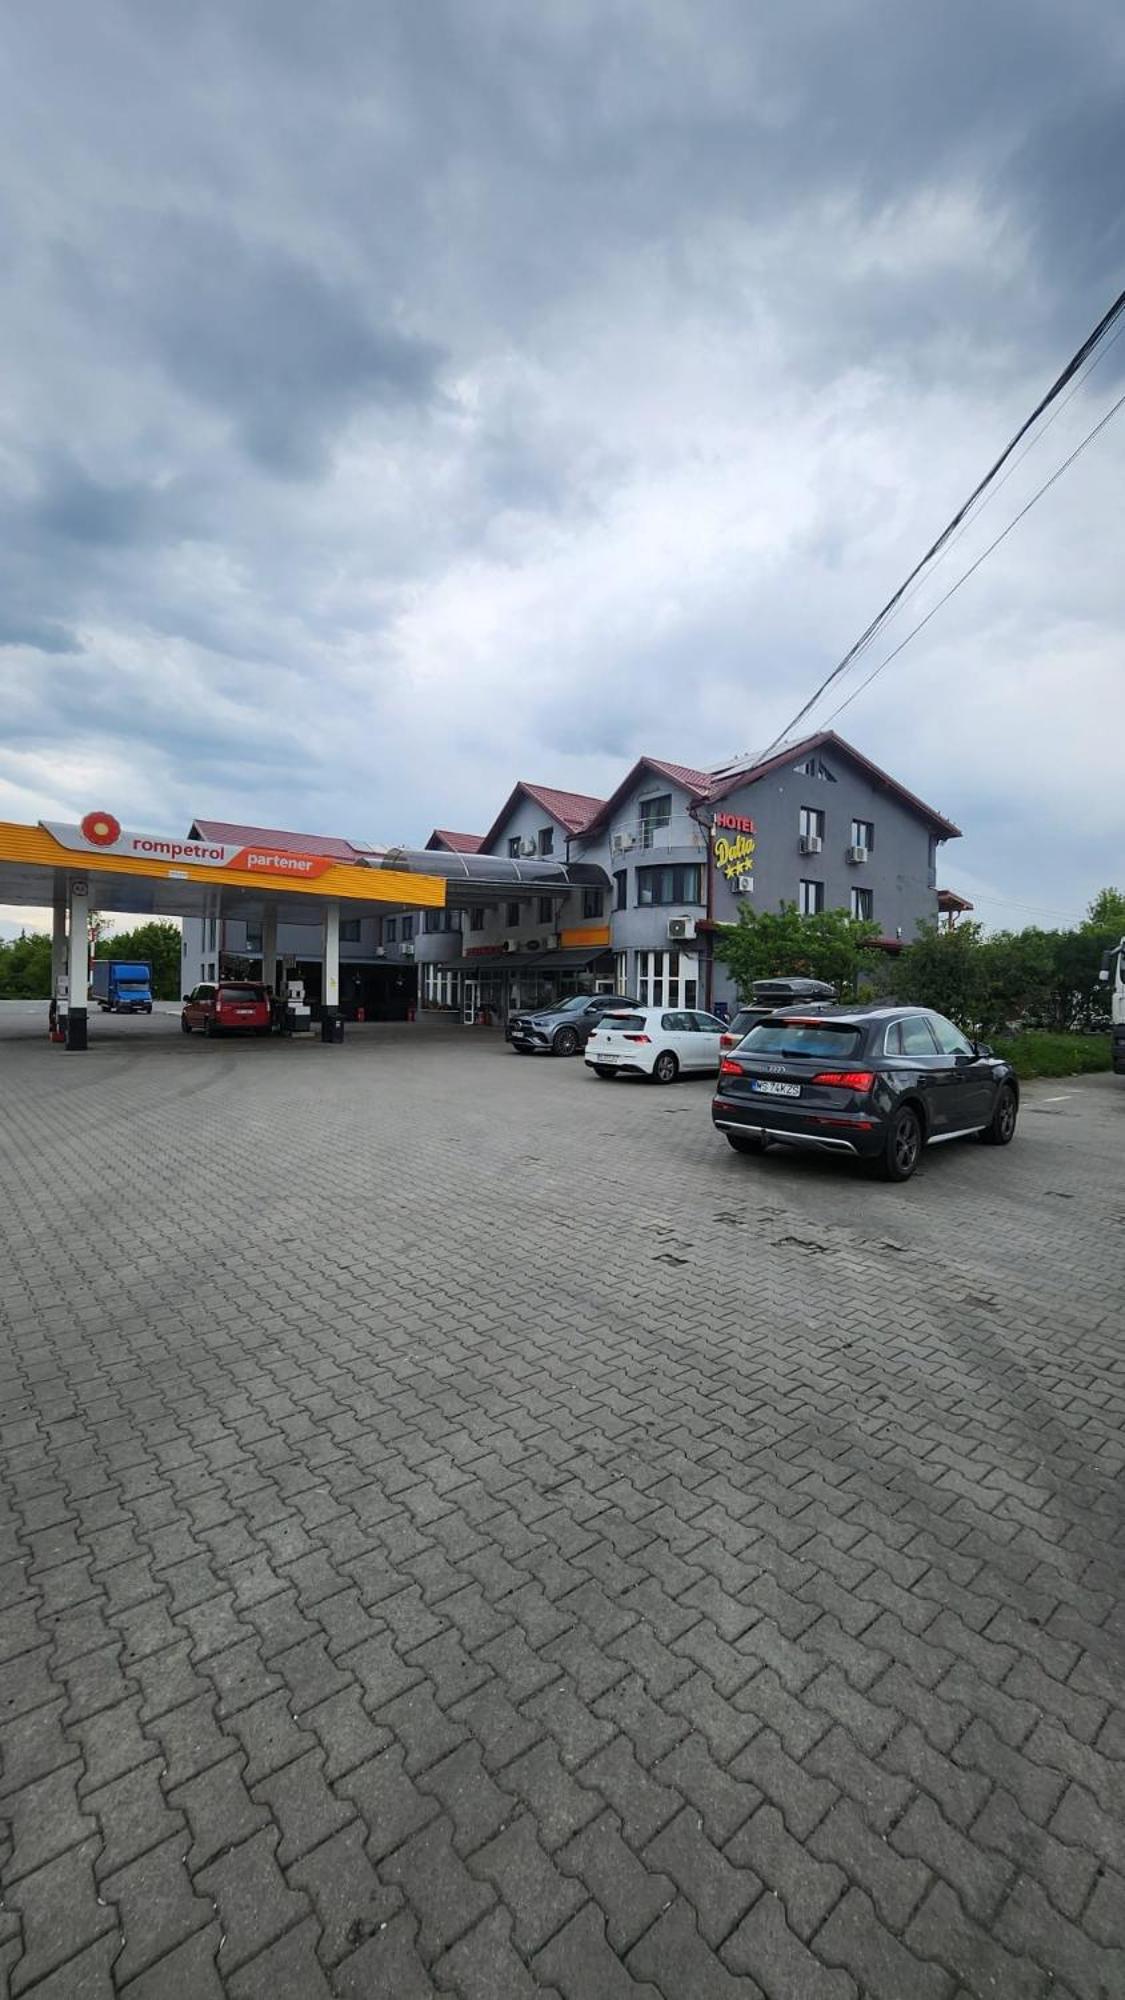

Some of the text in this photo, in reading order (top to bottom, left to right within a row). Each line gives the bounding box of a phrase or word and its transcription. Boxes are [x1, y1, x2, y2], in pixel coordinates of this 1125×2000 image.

[716, 813, 757, 832] HOTEL
[133, 838, 225, 860] rompetrol
[715, 835, 755, 867] Dalia
[247, 852, 313, 871] partener
